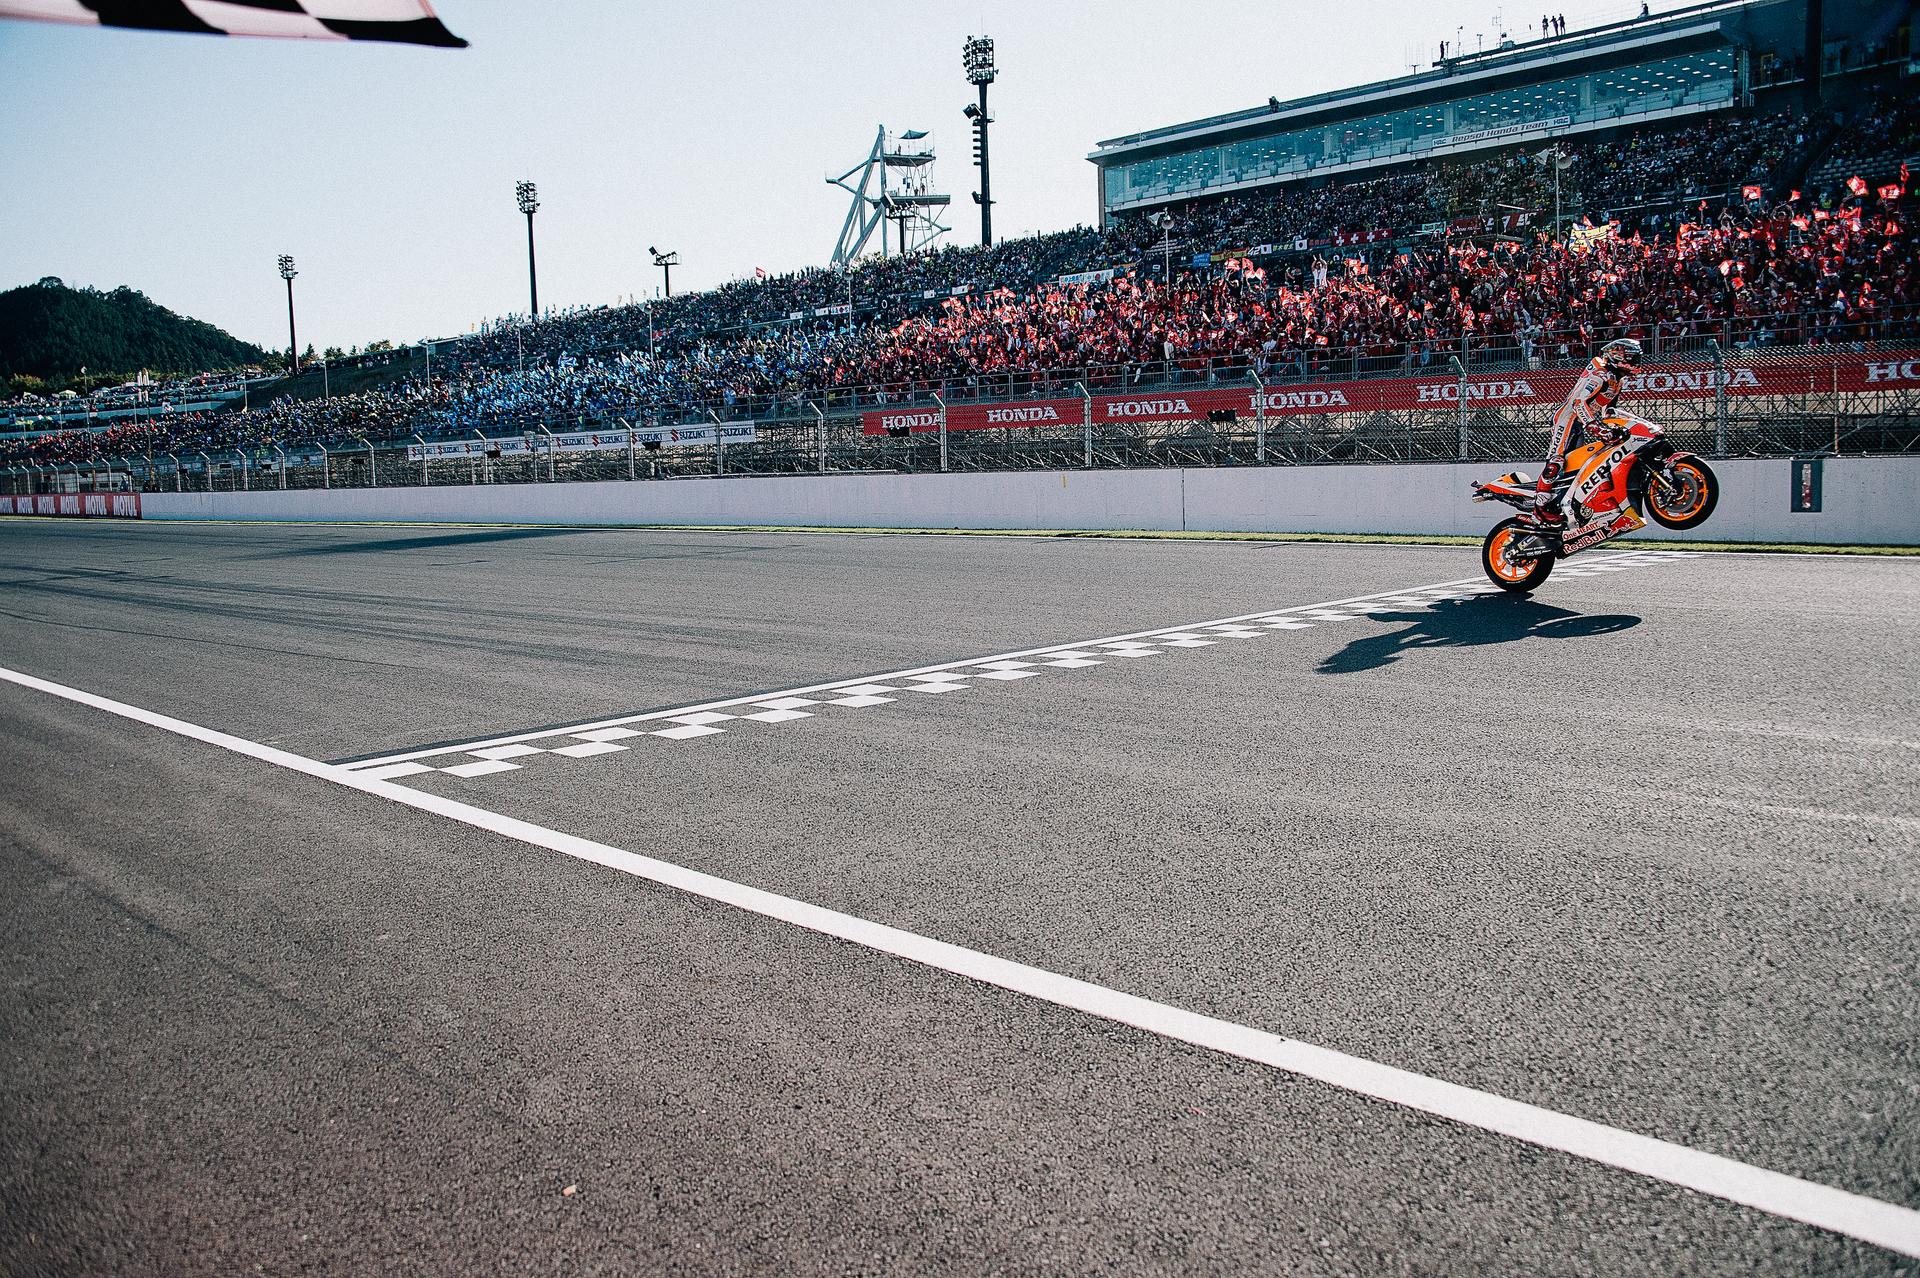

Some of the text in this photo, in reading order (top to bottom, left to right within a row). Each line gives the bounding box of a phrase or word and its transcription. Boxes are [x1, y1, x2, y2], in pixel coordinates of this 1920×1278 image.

[1452, 131, 1485, 143] Repsol
[1486, 126, 1518, 137] Honda
[1521, 121, 1548, 131] Team
[1620, 368, 1762, 393] HONDA
[1248, 390, 1350, 410] HONDA
[1416, 380, 1537, 402] HONDA
[987, 406, 1060, 423] HONDA
[1107, 399, 1192, 417] HONDA
[881, 413, 944, 429] HONDA
[600, 436, 622, 444] SUZUKI
[638, 433, 663, 441] SUZUKI
[679, 431, 705, 439] SUZUKI
[723, 428, 752, 437] SUZUKI
[562, 438, 585, 446] SUZUKI
[60, 495, 80, 515] MOTUL
[85, 495, 107, 515] MOTUL
[113, 495, 138, 516] MOTUL
[1563, 532, 1577, 540] One
[1563, 539, 1587, 554] Red
[1583, 530, 1607, 546] Bull
